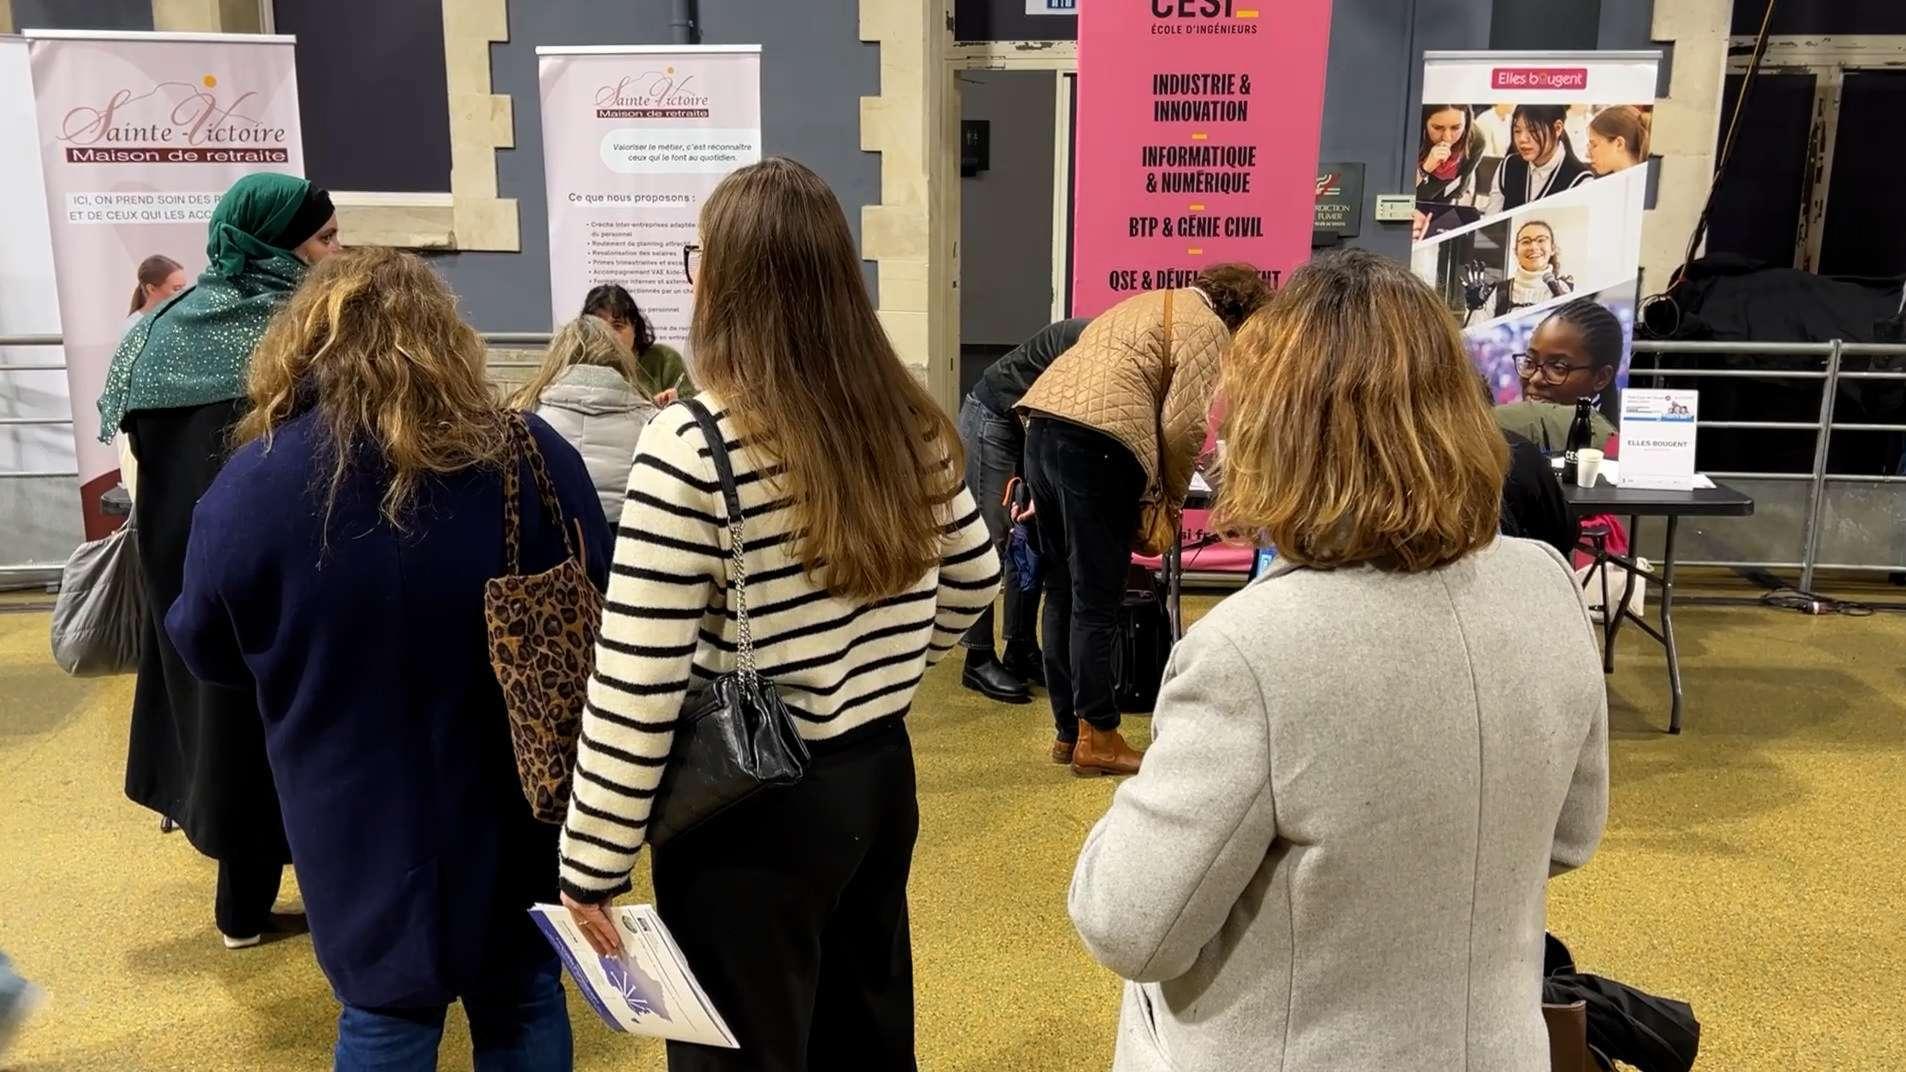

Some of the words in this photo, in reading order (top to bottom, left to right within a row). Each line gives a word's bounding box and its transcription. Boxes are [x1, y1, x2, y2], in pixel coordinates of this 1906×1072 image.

[1151, 23, 1182, 34] ÉCOLE
[1186, 23, 1258, 34] D'INGÉNIEURS
[1152, 73, 1235, 95] INDUSTRIE
[1239, 73, 1251, 95] &
[1498, 72, 1526, 85] Elles
[600, 110, 643, 118] Maison
[647, 110, 664, 118] de
[666, 110, 708, 118] retraite
[1154, 100, 1248, 122] INNOVATION
[613, 143, 647, 151] Valoriser
[649, 143, 655, 151] le
[72, 149, 160, 162] Maison
[168, 149, 198, 162] de
[206, 150, 287, 162] retraite
[648, 154, 660, 163] qui
[1142, 146, 1257, 168] INFORMATIQUE
[1146, 172, 1157, 193] &
[1161, 169, 1251, 194] NUMÉRIQUE
[73, 195, 92, 206] ICI,
[94, 195, 112, 205] ON
[116, 195, 154, 205] PREND
[158, 195, 185, 205] SOIN
[188, 195, 211, 205] DES
[568, 192, 582, 202] Ce
[585, 194, 604, 205] que
[606, 194, 631, 202] nous
[634, 194, 690, 205] proposons
[69, 211, 83, 221] ET
[87, 211, 102, 221] DE
[105, 211, 138, 221] CEUX
[141, 211, 161, 221] QUI
[164, 211, 185, 220] LES
[1129, 216, 1158, 237] BTP
[1162, 216, 1173, 237] &
[1177, 215, 1220, 237] GÉNIE
[1224, 216, 1263, 237] CIVIL
[1109, 270, 1138, 291] QSE
[1141, 270, 1153, 290] &
[1653, 440, 1688, 448] BOUGENT
